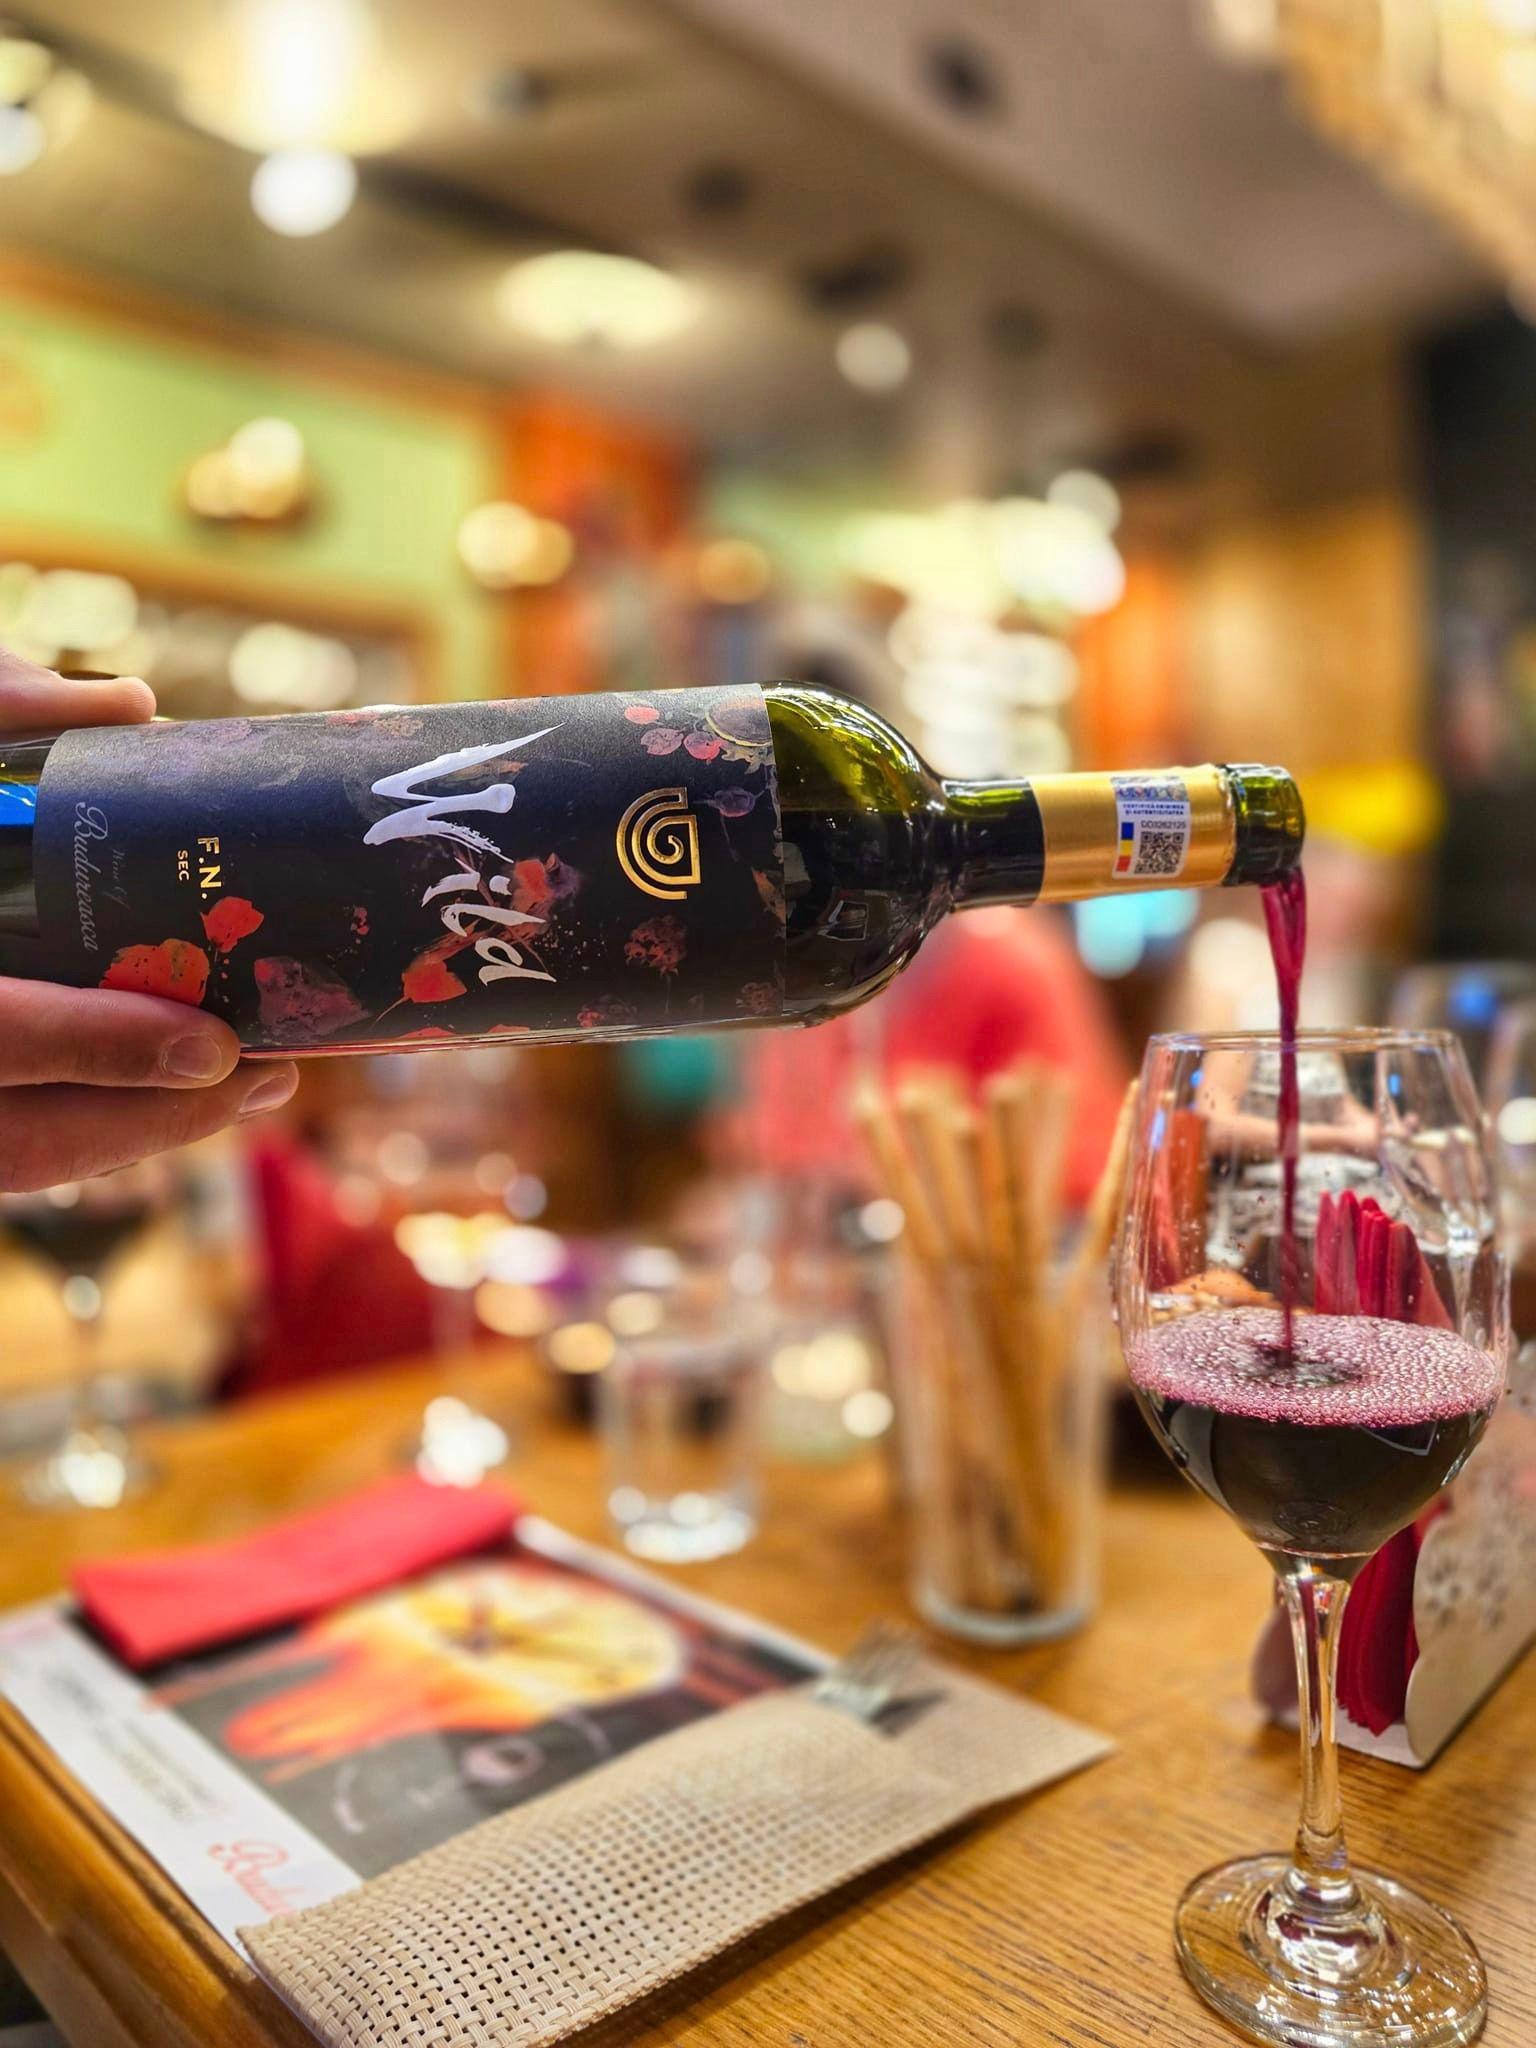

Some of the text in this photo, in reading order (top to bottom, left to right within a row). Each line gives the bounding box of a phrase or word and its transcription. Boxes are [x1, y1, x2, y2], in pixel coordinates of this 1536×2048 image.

[74, 801, 109, 951] Budureasca
[177, 850, 190, 881] SEC
[197, 836, 223, 899] F.N.
[363, 722, 566, 986] Wild
